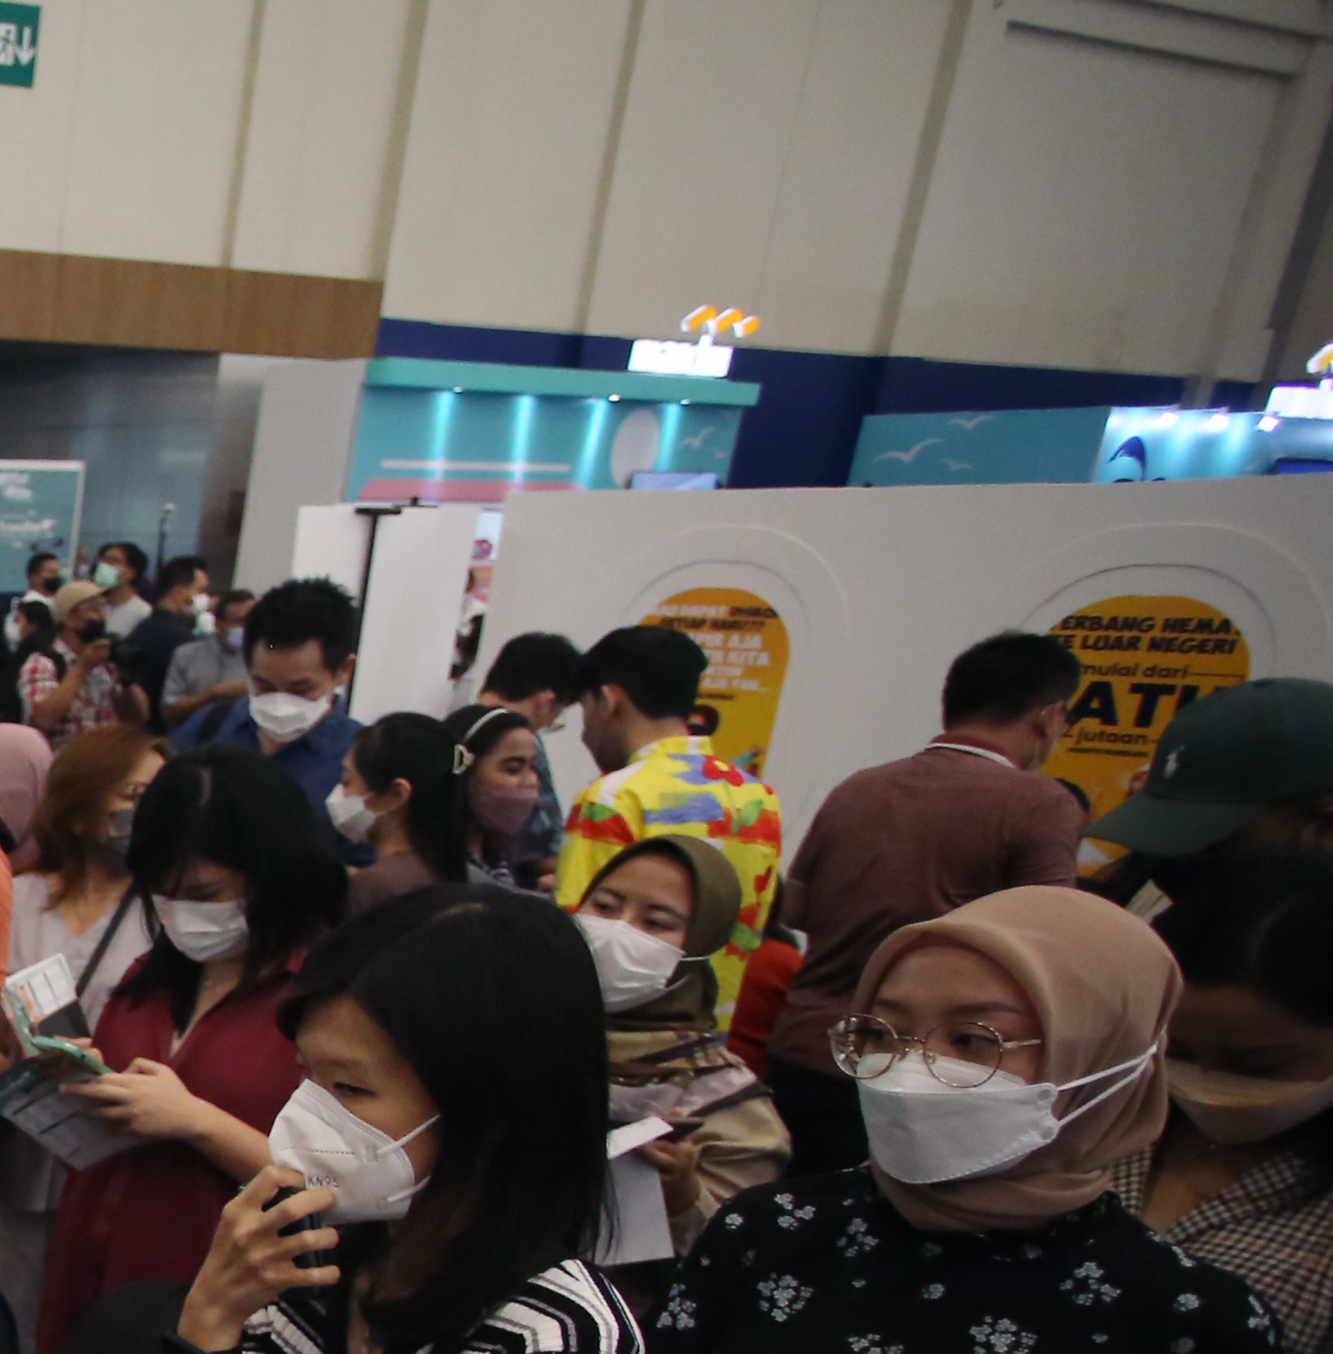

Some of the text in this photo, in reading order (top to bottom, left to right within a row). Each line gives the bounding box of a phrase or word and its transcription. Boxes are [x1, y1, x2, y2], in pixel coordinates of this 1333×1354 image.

[1051, 615, 1155, 632] ERBANG
[1080, 635, 1142, 652] LUAR
[1147, 637, 1239, 655] NEGERI
[1079, 663, 1189, 678] mulai dari
[1076, 727, 1149, 746] jutaan
[307, 1175, 340, 1188] KN95
